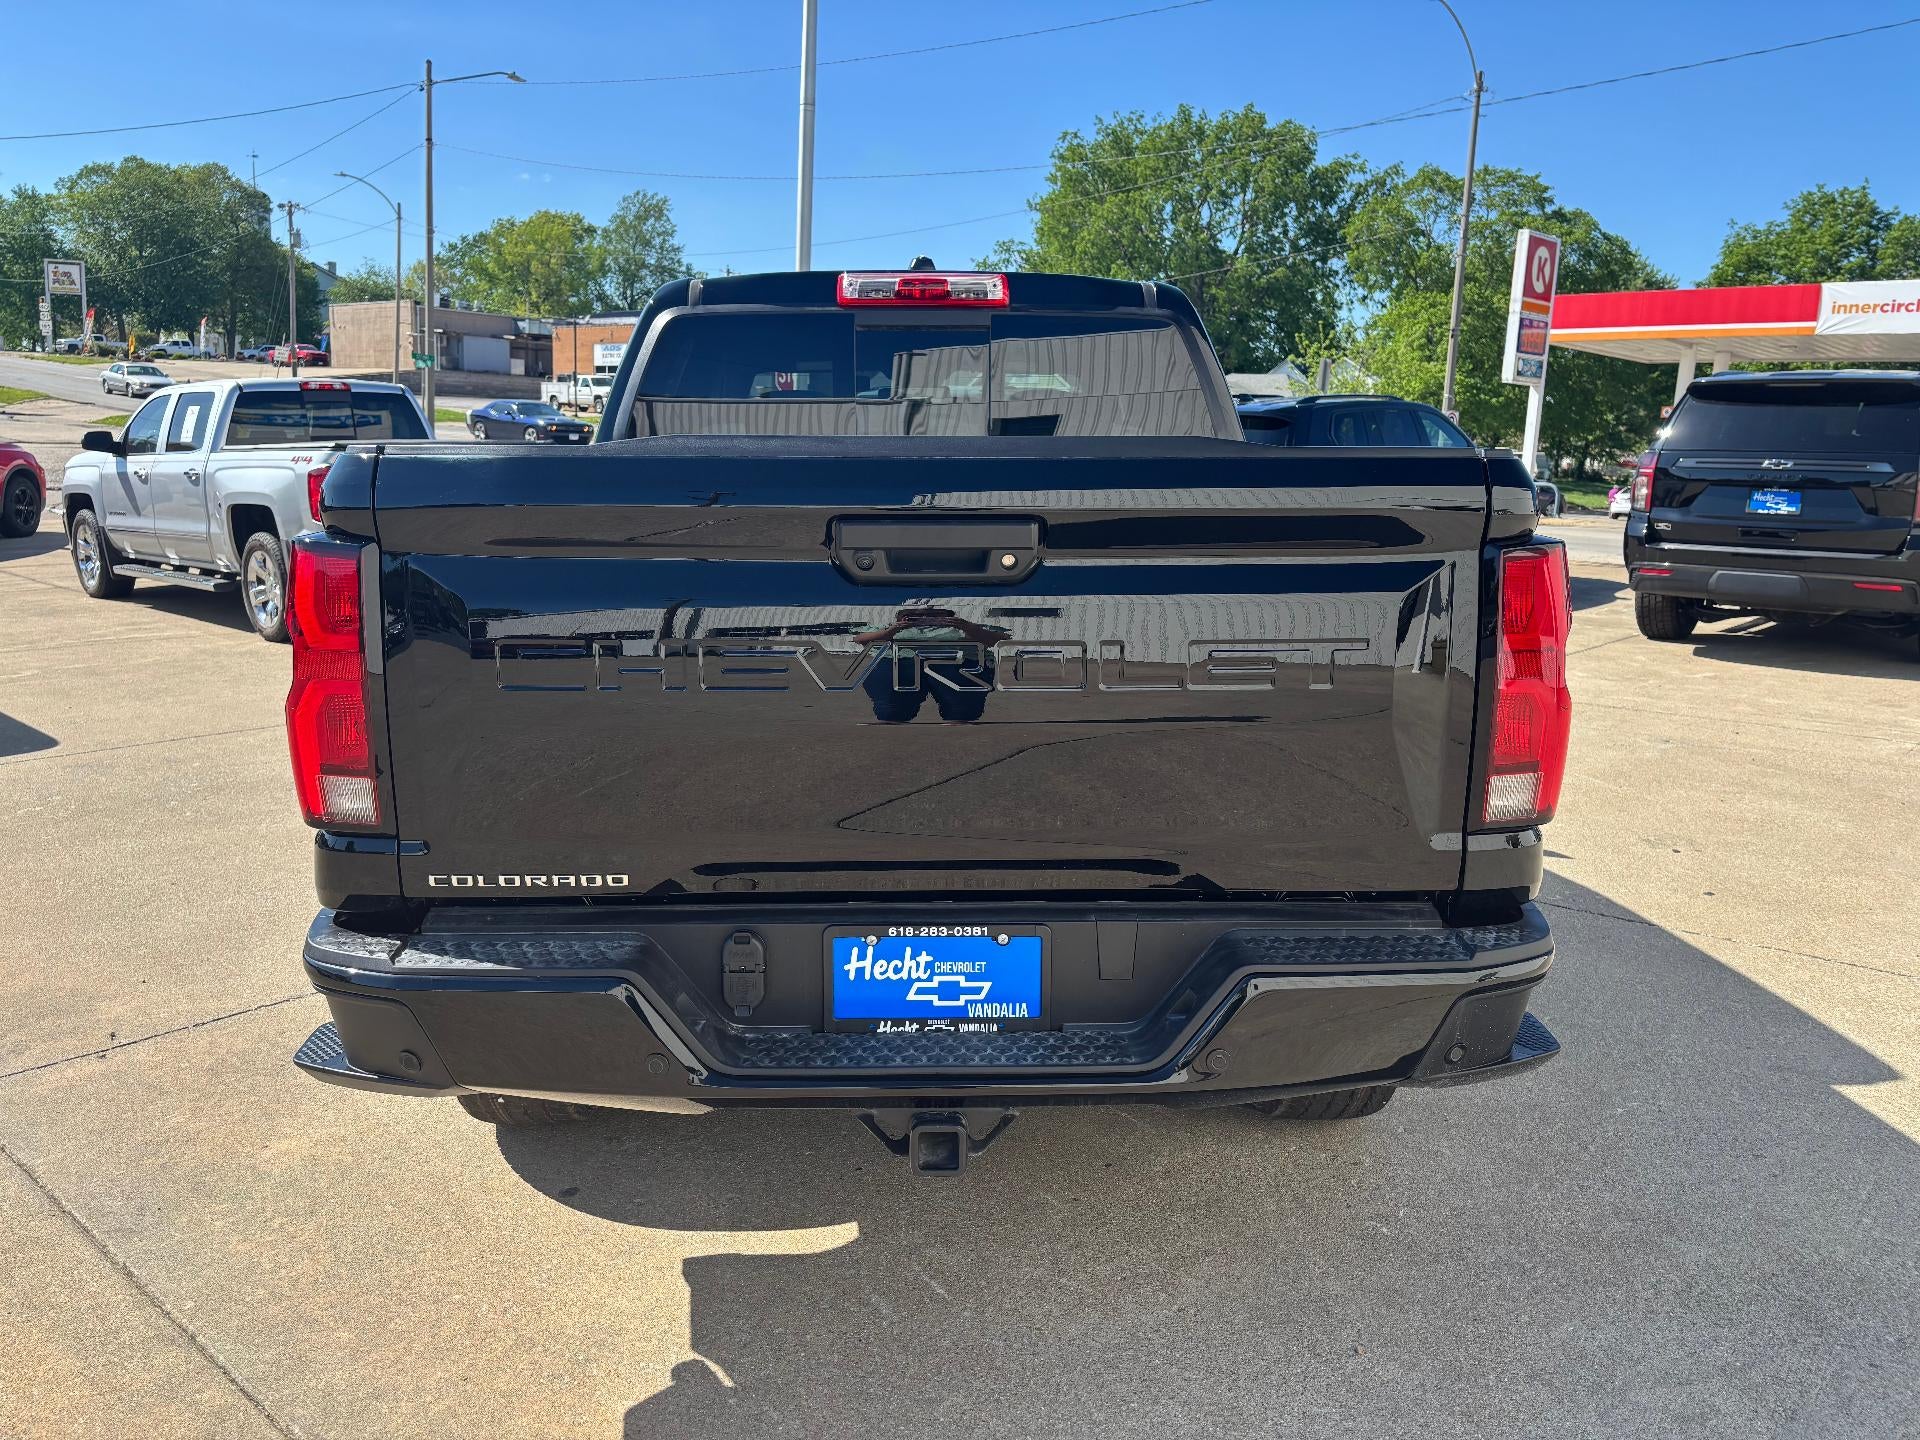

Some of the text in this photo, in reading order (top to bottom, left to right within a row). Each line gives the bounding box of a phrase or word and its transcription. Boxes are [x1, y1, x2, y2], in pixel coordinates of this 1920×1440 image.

[495, 637, 1370, 691] CHEVROLET
[428, 874, 629, 887] COLORADO
[888, 926, 989, 937] 618-283-0381
[843, 946, 987, 981] Hecht CHEVROLET
[967, 1002, 1029, 1018] VANDALIA
